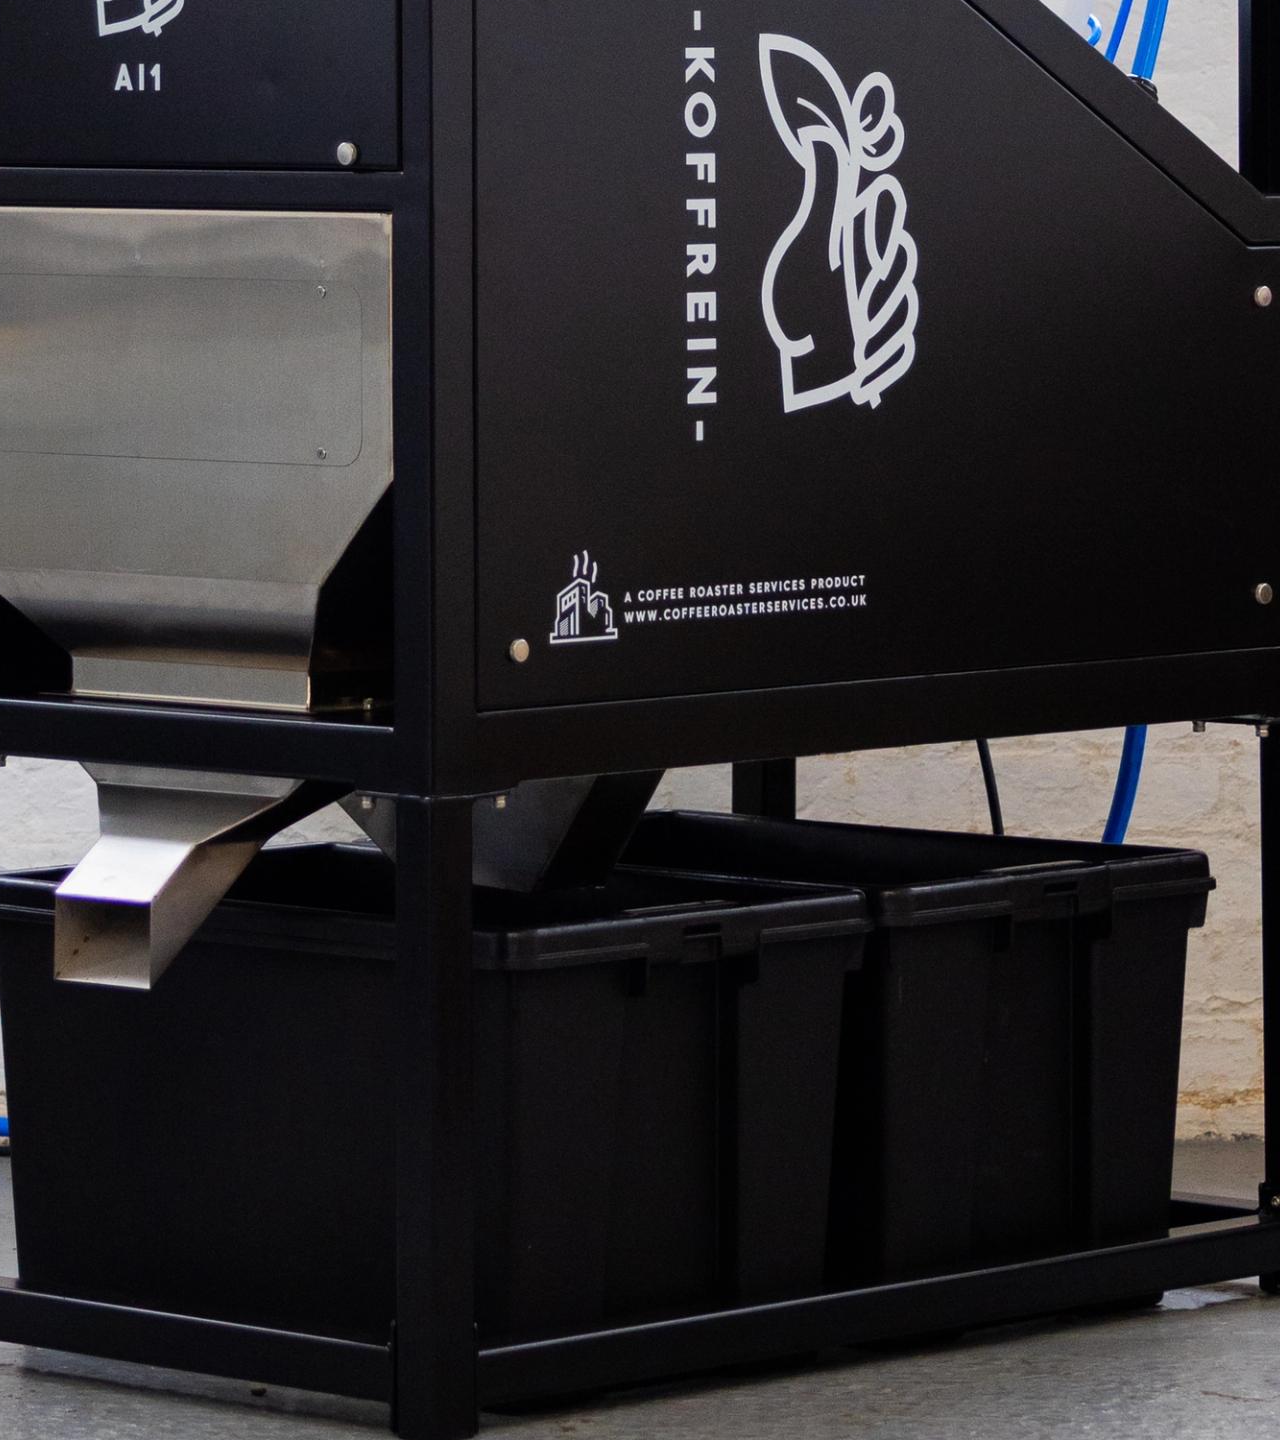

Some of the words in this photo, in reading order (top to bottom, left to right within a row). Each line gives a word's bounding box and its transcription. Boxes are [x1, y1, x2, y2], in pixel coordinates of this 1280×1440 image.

[624, 591, 632, 603] A
[638, 587, 684, 602] COFFEE
[689, 584, 743, 599] ROASTER
[749, 579, 806, 595] SERVICES
[810, 575, 866, 591] PRODUCT
[624, 594, 867, 623] WWW.COFFEEROASTERSERVICES.CO.UK
